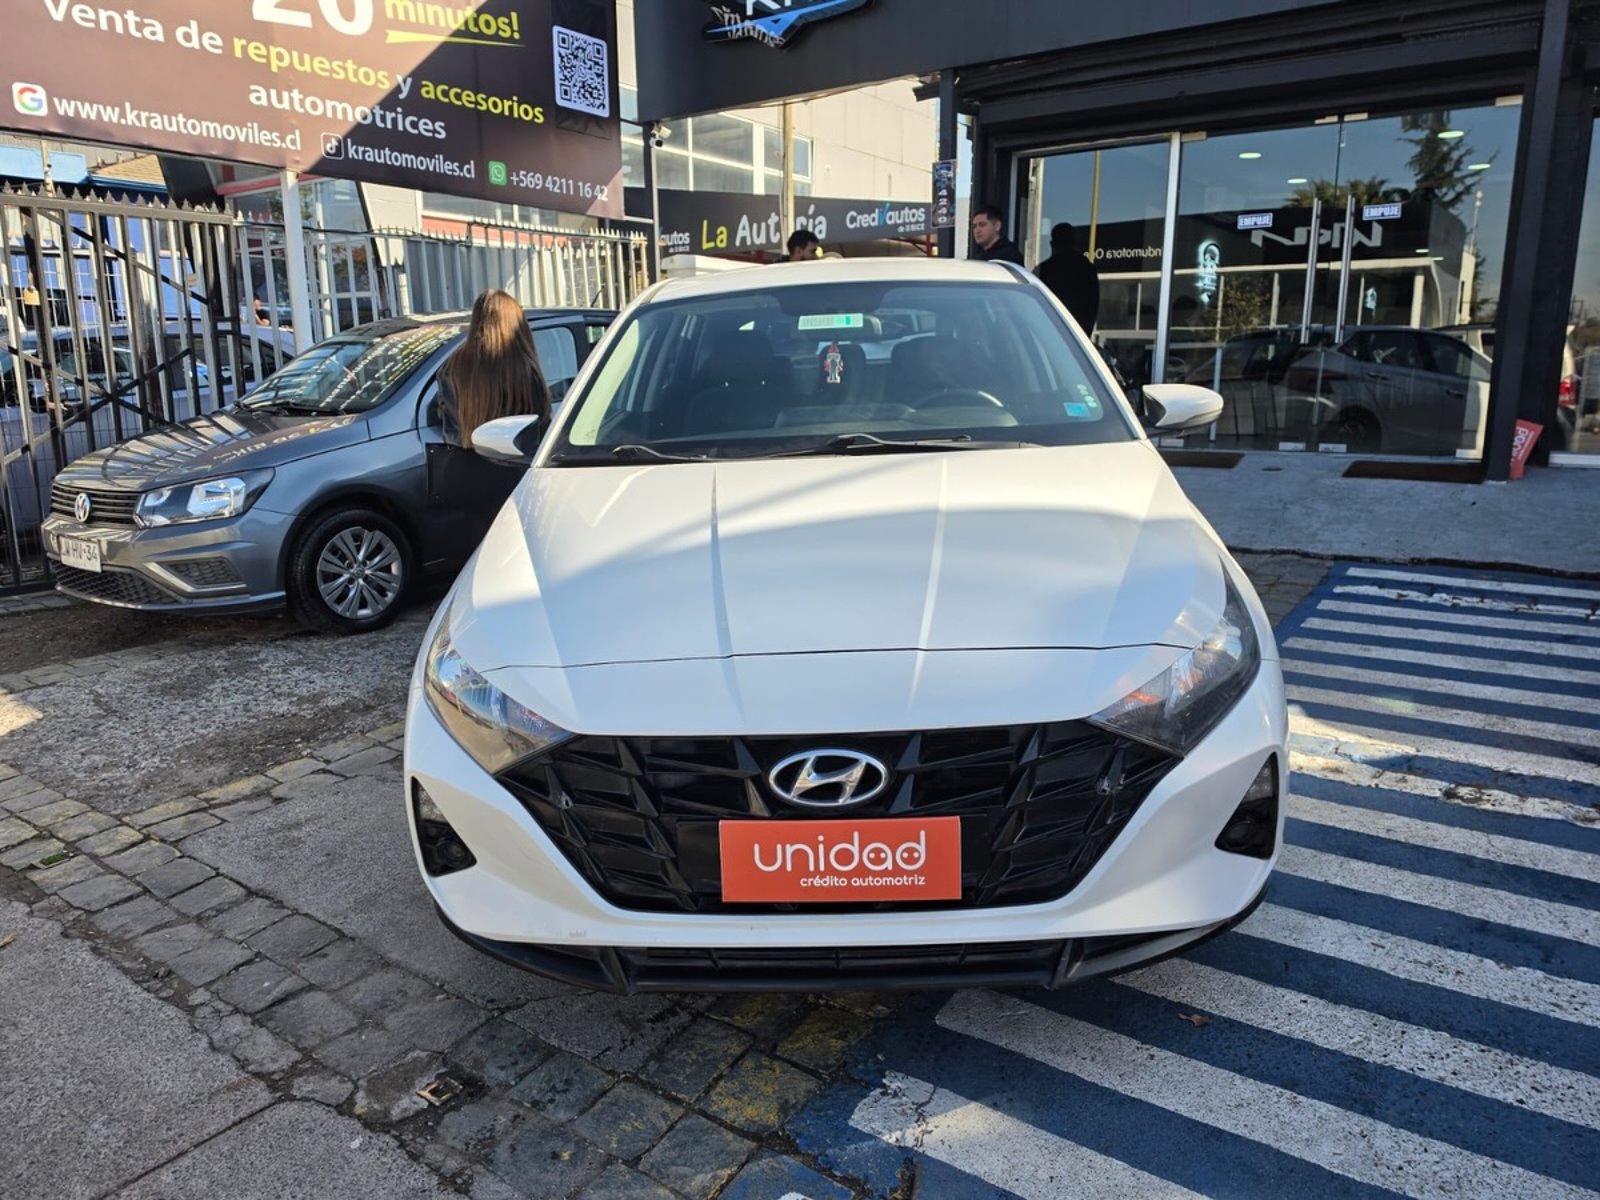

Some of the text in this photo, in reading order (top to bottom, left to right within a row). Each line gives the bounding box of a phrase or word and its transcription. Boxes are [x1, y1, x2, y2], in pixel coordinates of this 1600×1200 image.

[385, 0, 520, 39] minutos!
[44, 0, 544, 124] Venta de repuestos y accesorios
[53, 96, 301, 150] www.krautomoviles.cl
[249, 84, 447, 139] automotrices
[347, 139, 475, 178] krautomoviles.cl
[510, 171, 608, 201] +569 4211 16 42
[702, 204, 827, 250] La Autría
[1239, 215, 1271, 226] EMPUJE
[1364, 205, 1400, 217] EMPUJE
[754, 830, 926, 872] unidad
[799, 874, 926, 887] crédito automotriz
